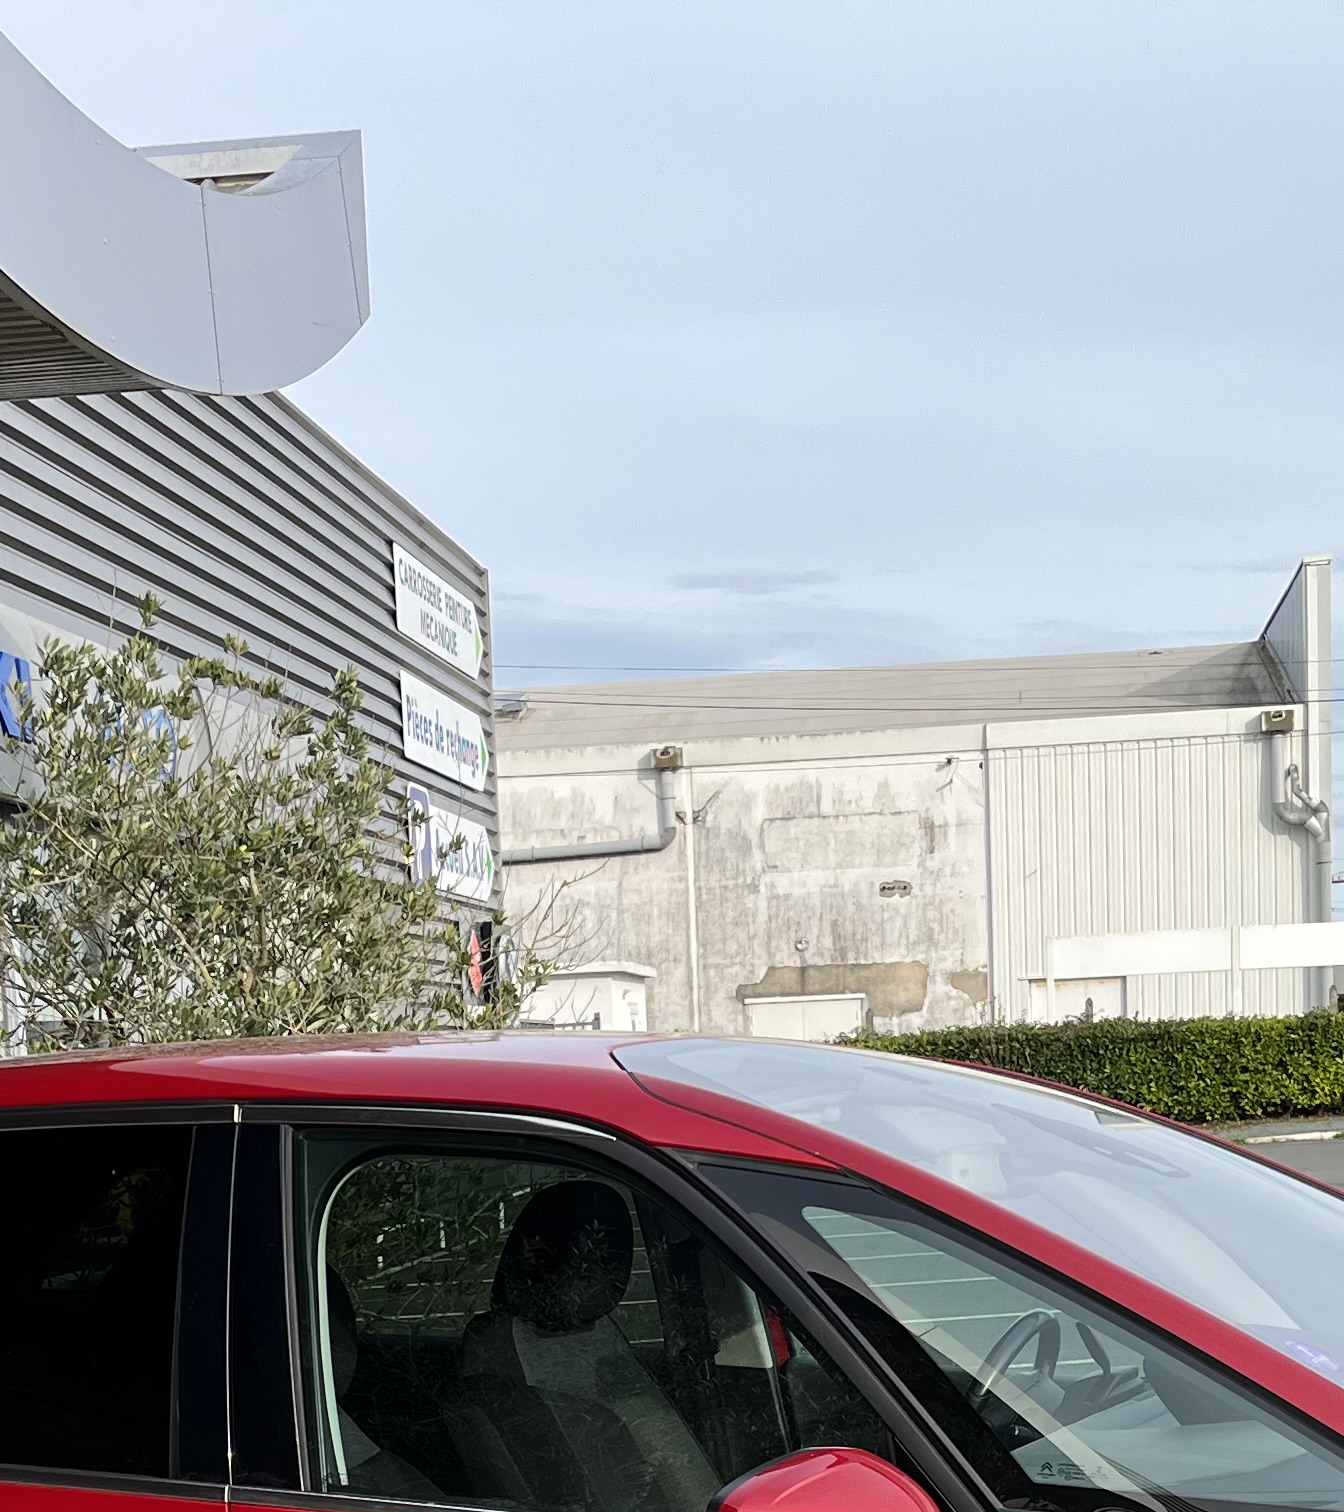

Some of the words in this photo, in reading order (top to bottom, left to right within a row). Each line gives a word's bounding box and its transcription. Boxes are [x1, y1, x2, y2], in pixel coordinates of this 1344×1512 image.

[398, 557, 443, 613] CARROSSERIE
[444, 591, 473, 634] PEINTURE
[420, 608, 457, 657] MECANIQUE
[406, 694, 433, 748] Pièces
[435, 709, 444, 754] de
[446, 720, 480, 779] rechange
